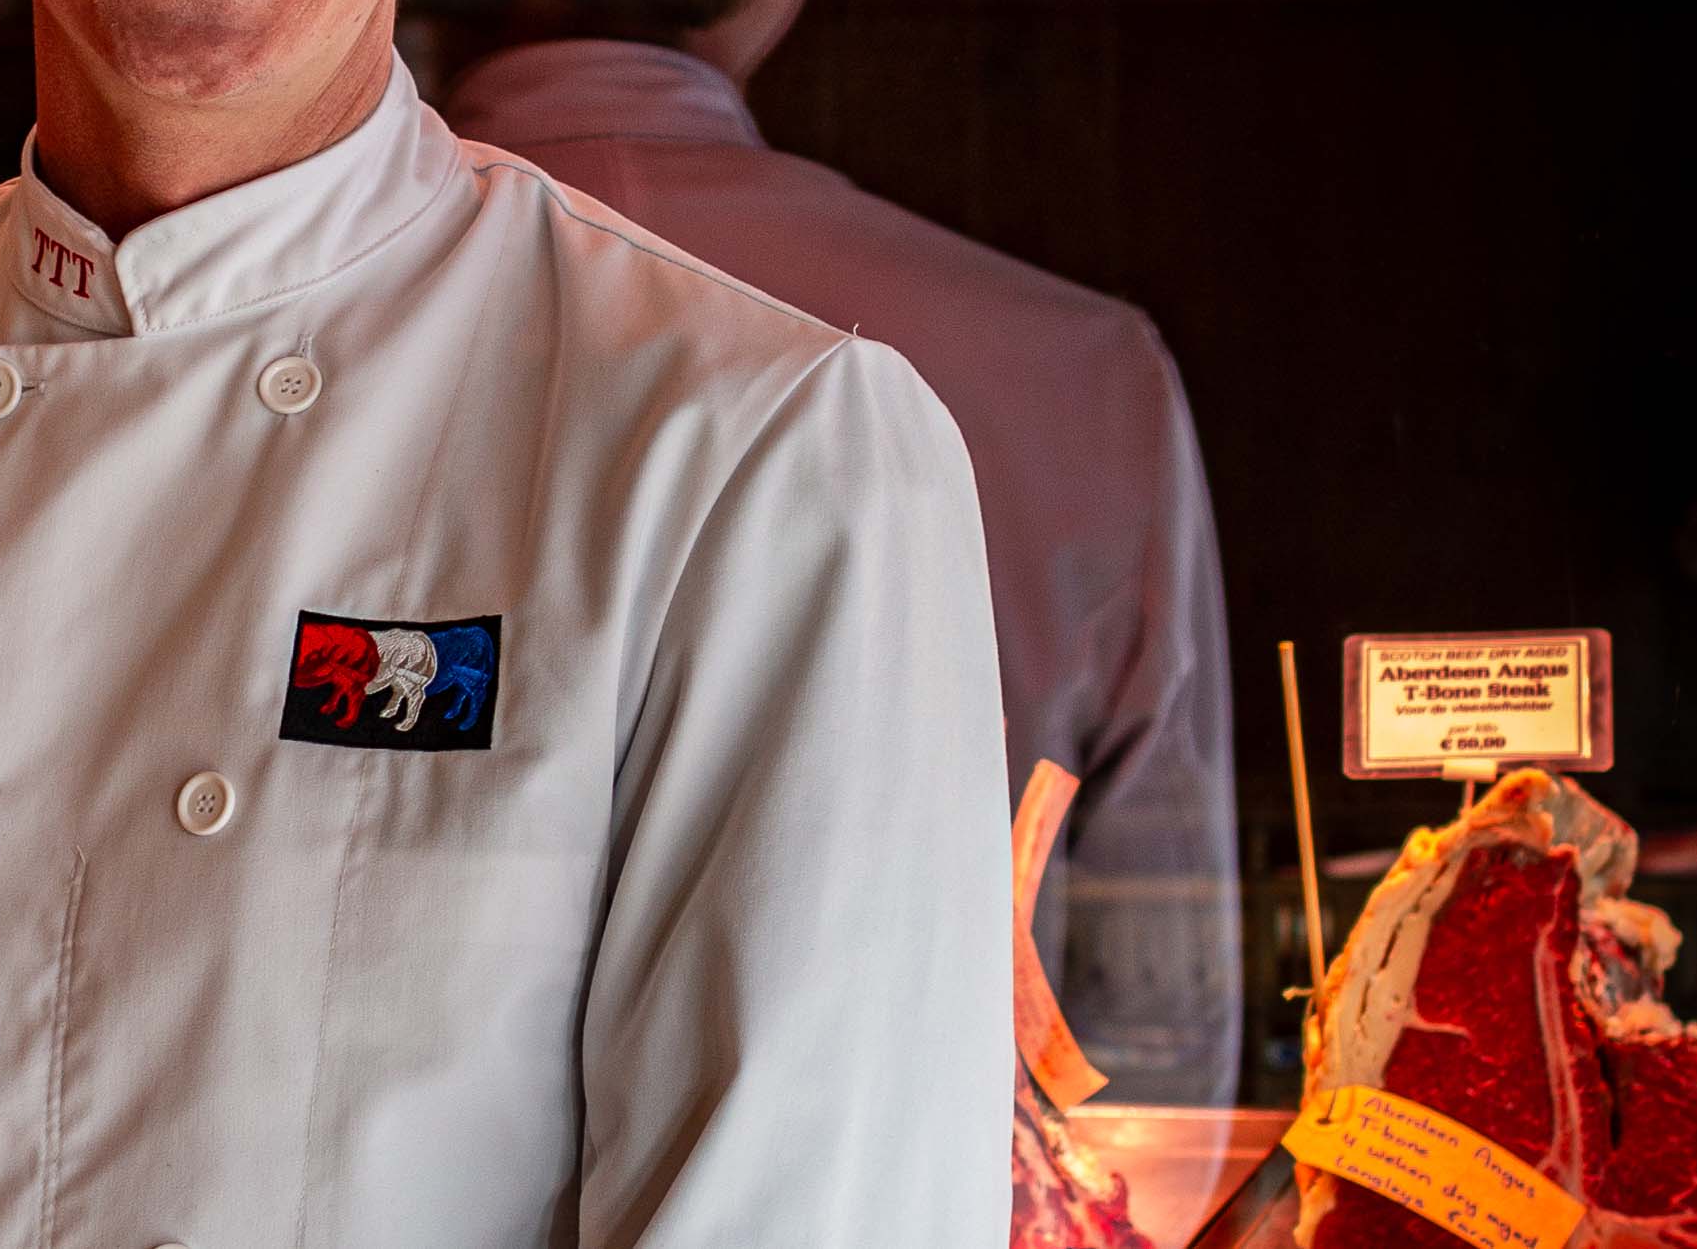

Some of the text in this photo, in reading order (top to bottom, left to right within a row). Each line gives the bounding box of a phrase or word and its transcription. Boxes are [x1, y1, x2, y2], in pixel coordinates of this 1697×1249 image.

[32, 227, 95, 299] TTT
[1379, 662, 1569, 682] Aberdeen Angus
[1403, 681, 1550, 701] T-Bone Steak
[1363, 1096, 1536, 1199] Aberdeen Angus
[1441, 1184, 1478, 1218] dry
